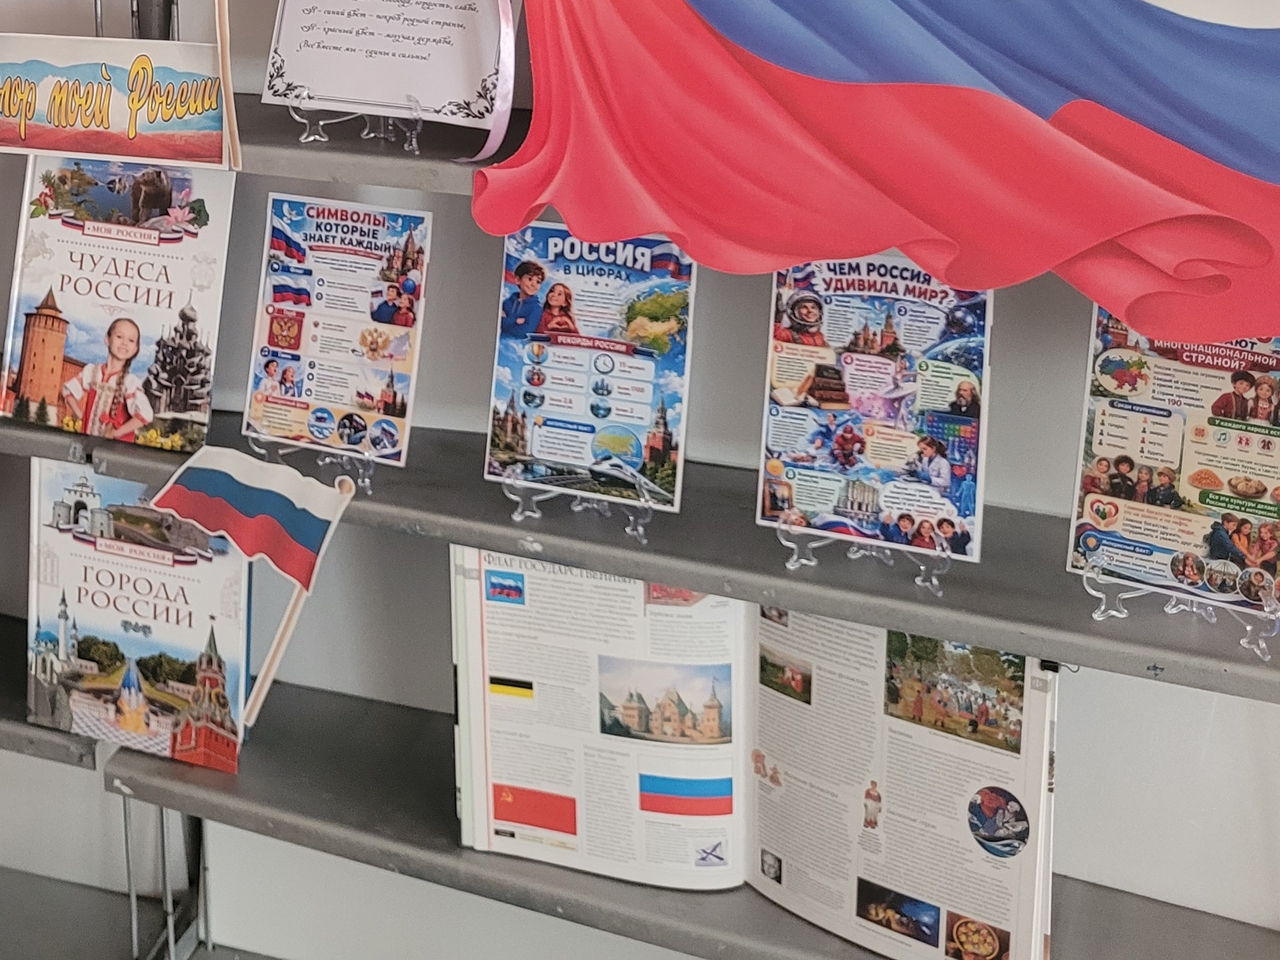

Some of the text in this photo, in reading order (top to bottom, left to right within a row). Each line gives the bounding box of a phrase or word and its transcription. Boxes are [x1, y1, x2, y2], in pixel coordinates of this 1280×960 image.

[46, 63, 113, 129] моей
[127, 54, 220, 140] России
[306, 206, 390, 231] СИМВОЛЫ,
[315, 221, 379, 239] КОТОРЫЕ
[91, 224, 153, 241] МОЯ РОССИЯ
[302, 232, 393, 253] ЗНАЕТ КАЖДЫЙ
[547, 236, 653, 272] РОССИЯ
[69, 250, 172, 285] ЧУДЕСА
[576, 264, 632, 283] ЦИФРАХ
[826, 262, 932, 286] ЧЕМ РОССИЯ
[58, 273, 174, 309] РОССИИ
[822, 277, 949, 305] УДИВИЛА МИР?
[1154, 339, 1277, 367] МНОГОНАЦИОНАЛЬНОЙ
[1182, 352, 1246, 371] СТРАНОЙ?
[1167, 397, 1182, 407] 190
[82, 564, 191, 605] ГОРОДА
[76, 586, 194, 629] РОССИИ
